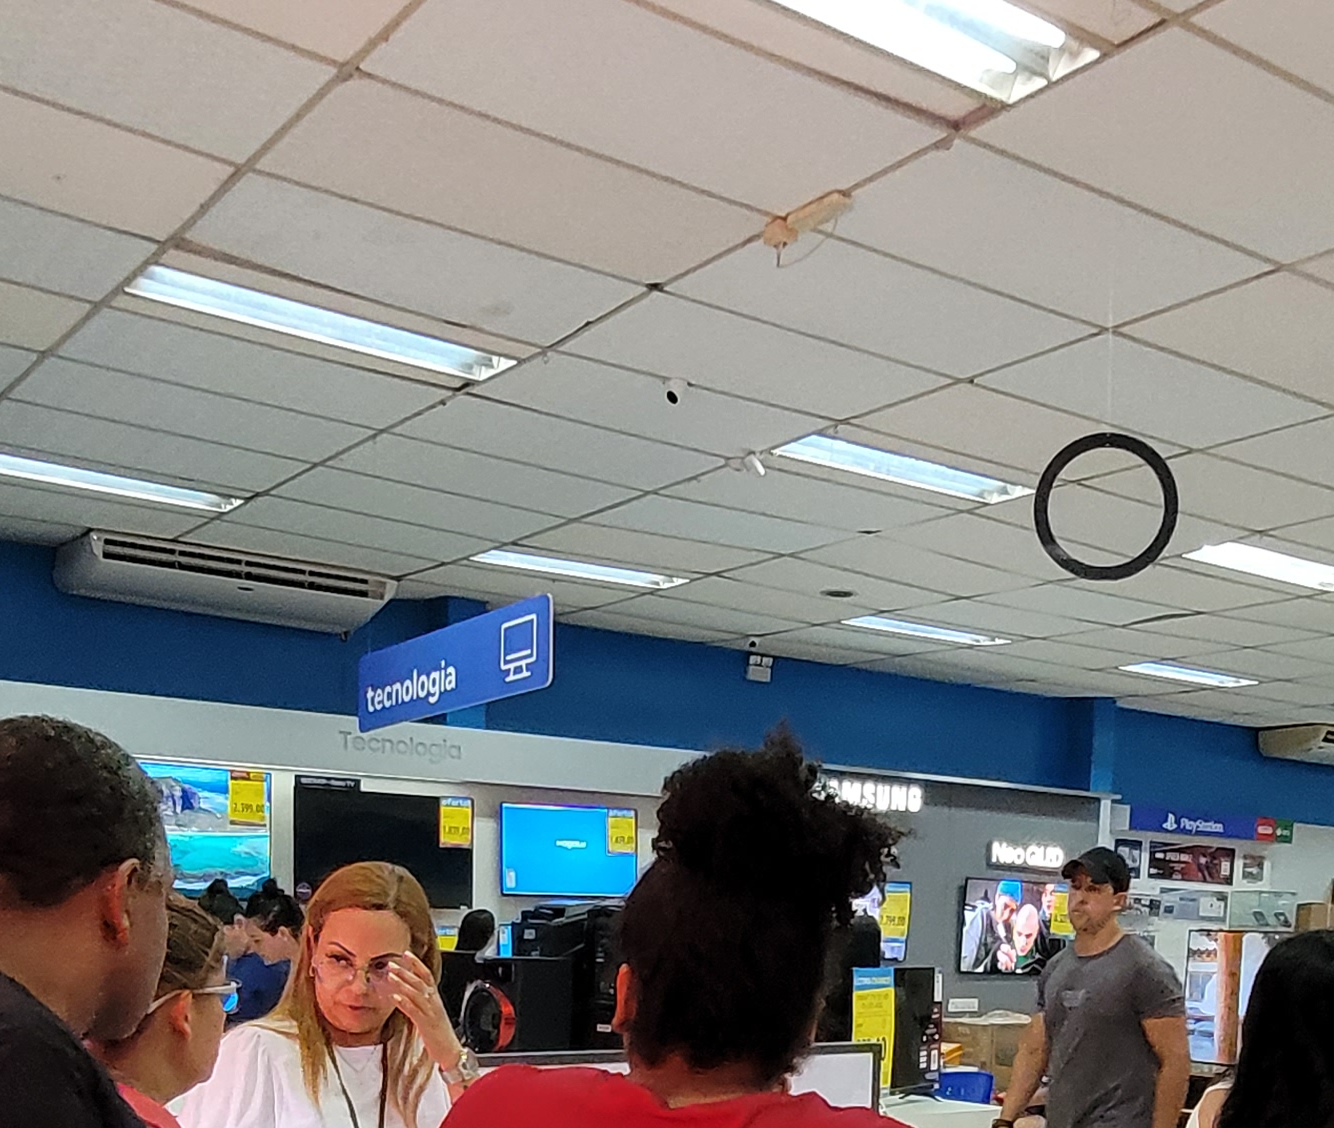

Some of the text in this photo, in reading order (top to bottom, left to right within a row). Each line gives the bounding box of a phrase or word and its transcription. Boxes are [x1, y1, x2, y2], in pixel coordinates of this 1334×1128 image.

[366, 659, 457, 713] tecnologia
[339, 730, 462, 764] Tecnologia
[817, 777, 922, 813] AMSUNG
[1180, 817, 1225, 834] PlayStation
[991, 841, 1065, 868] Neo QLED
